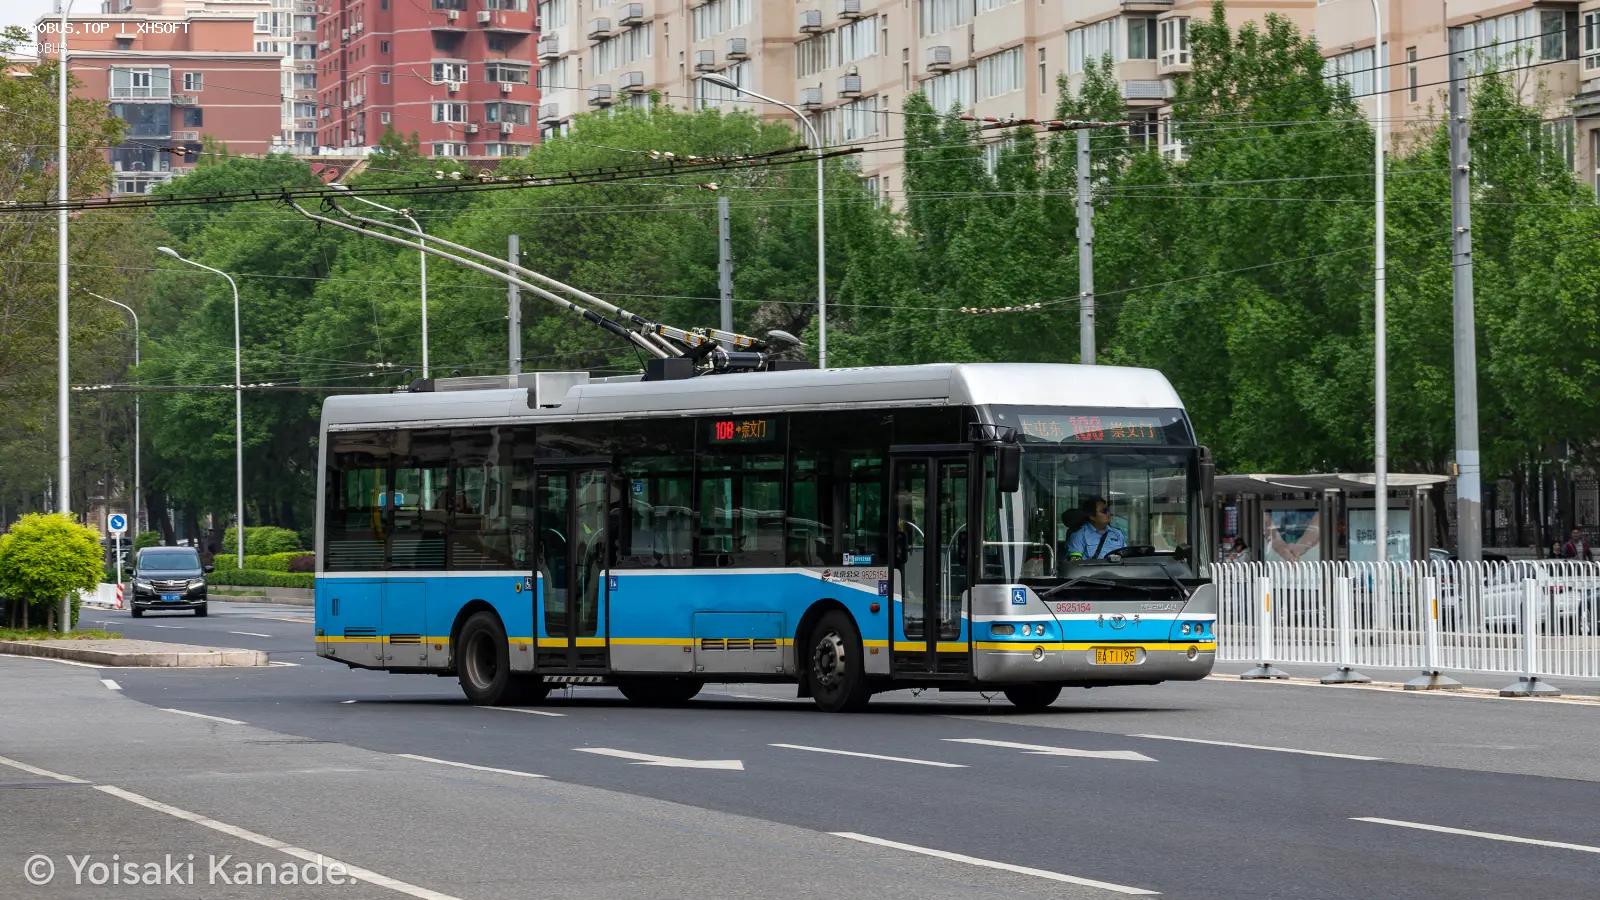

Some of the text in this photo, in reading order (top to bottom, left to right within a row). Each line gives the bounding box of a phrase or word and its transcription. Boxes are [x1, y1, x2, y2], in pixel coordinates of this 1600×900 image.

[715, 420, 766, 439] 108 崇文门
[1069, 416, 1104, 441] 108
[1110, 421, 1154, 438] 崇文门
[833, 570, 888, 580] 北京公交 9525154
[1056, 602, 1091, 612] 9525154
